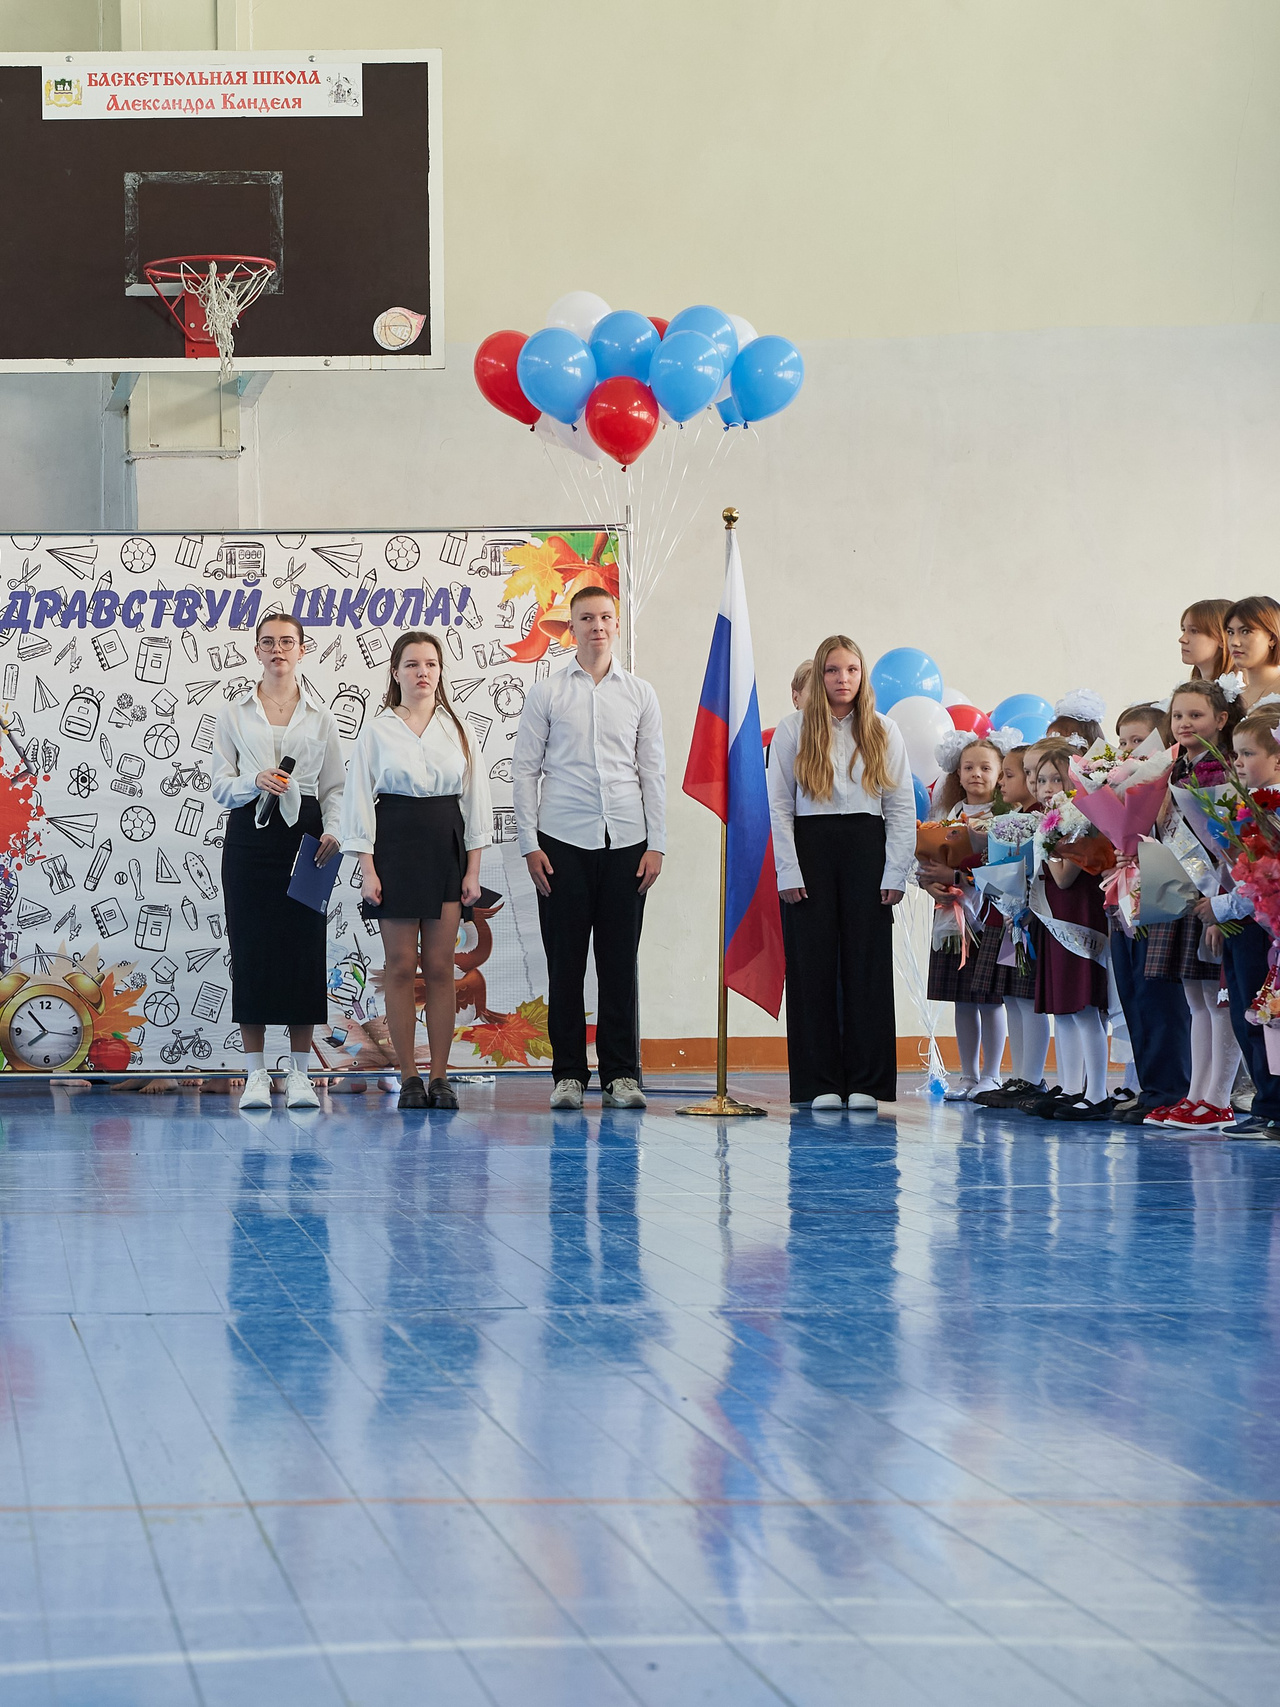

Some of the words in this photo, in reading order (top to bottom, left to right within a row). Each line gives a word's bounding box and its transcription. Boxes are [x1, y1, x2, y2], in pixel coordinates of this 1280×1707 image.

[87, 71, 247, 87] БАСКЕТБОЛЬНАЯ
[252, 70, 321, 85] ШКОЛА
[106, 94, 215, 115] Александра
[221, 93, 302, 113] Канделя
[291, 587, 471, 630] ШКОЛА!
[39, 1000, 52, 1010] 12
[15, 1027, 22, 1036] 9
[72, 1027, 79, 1036] 3
[43, 1055, 50, 1064] 6
